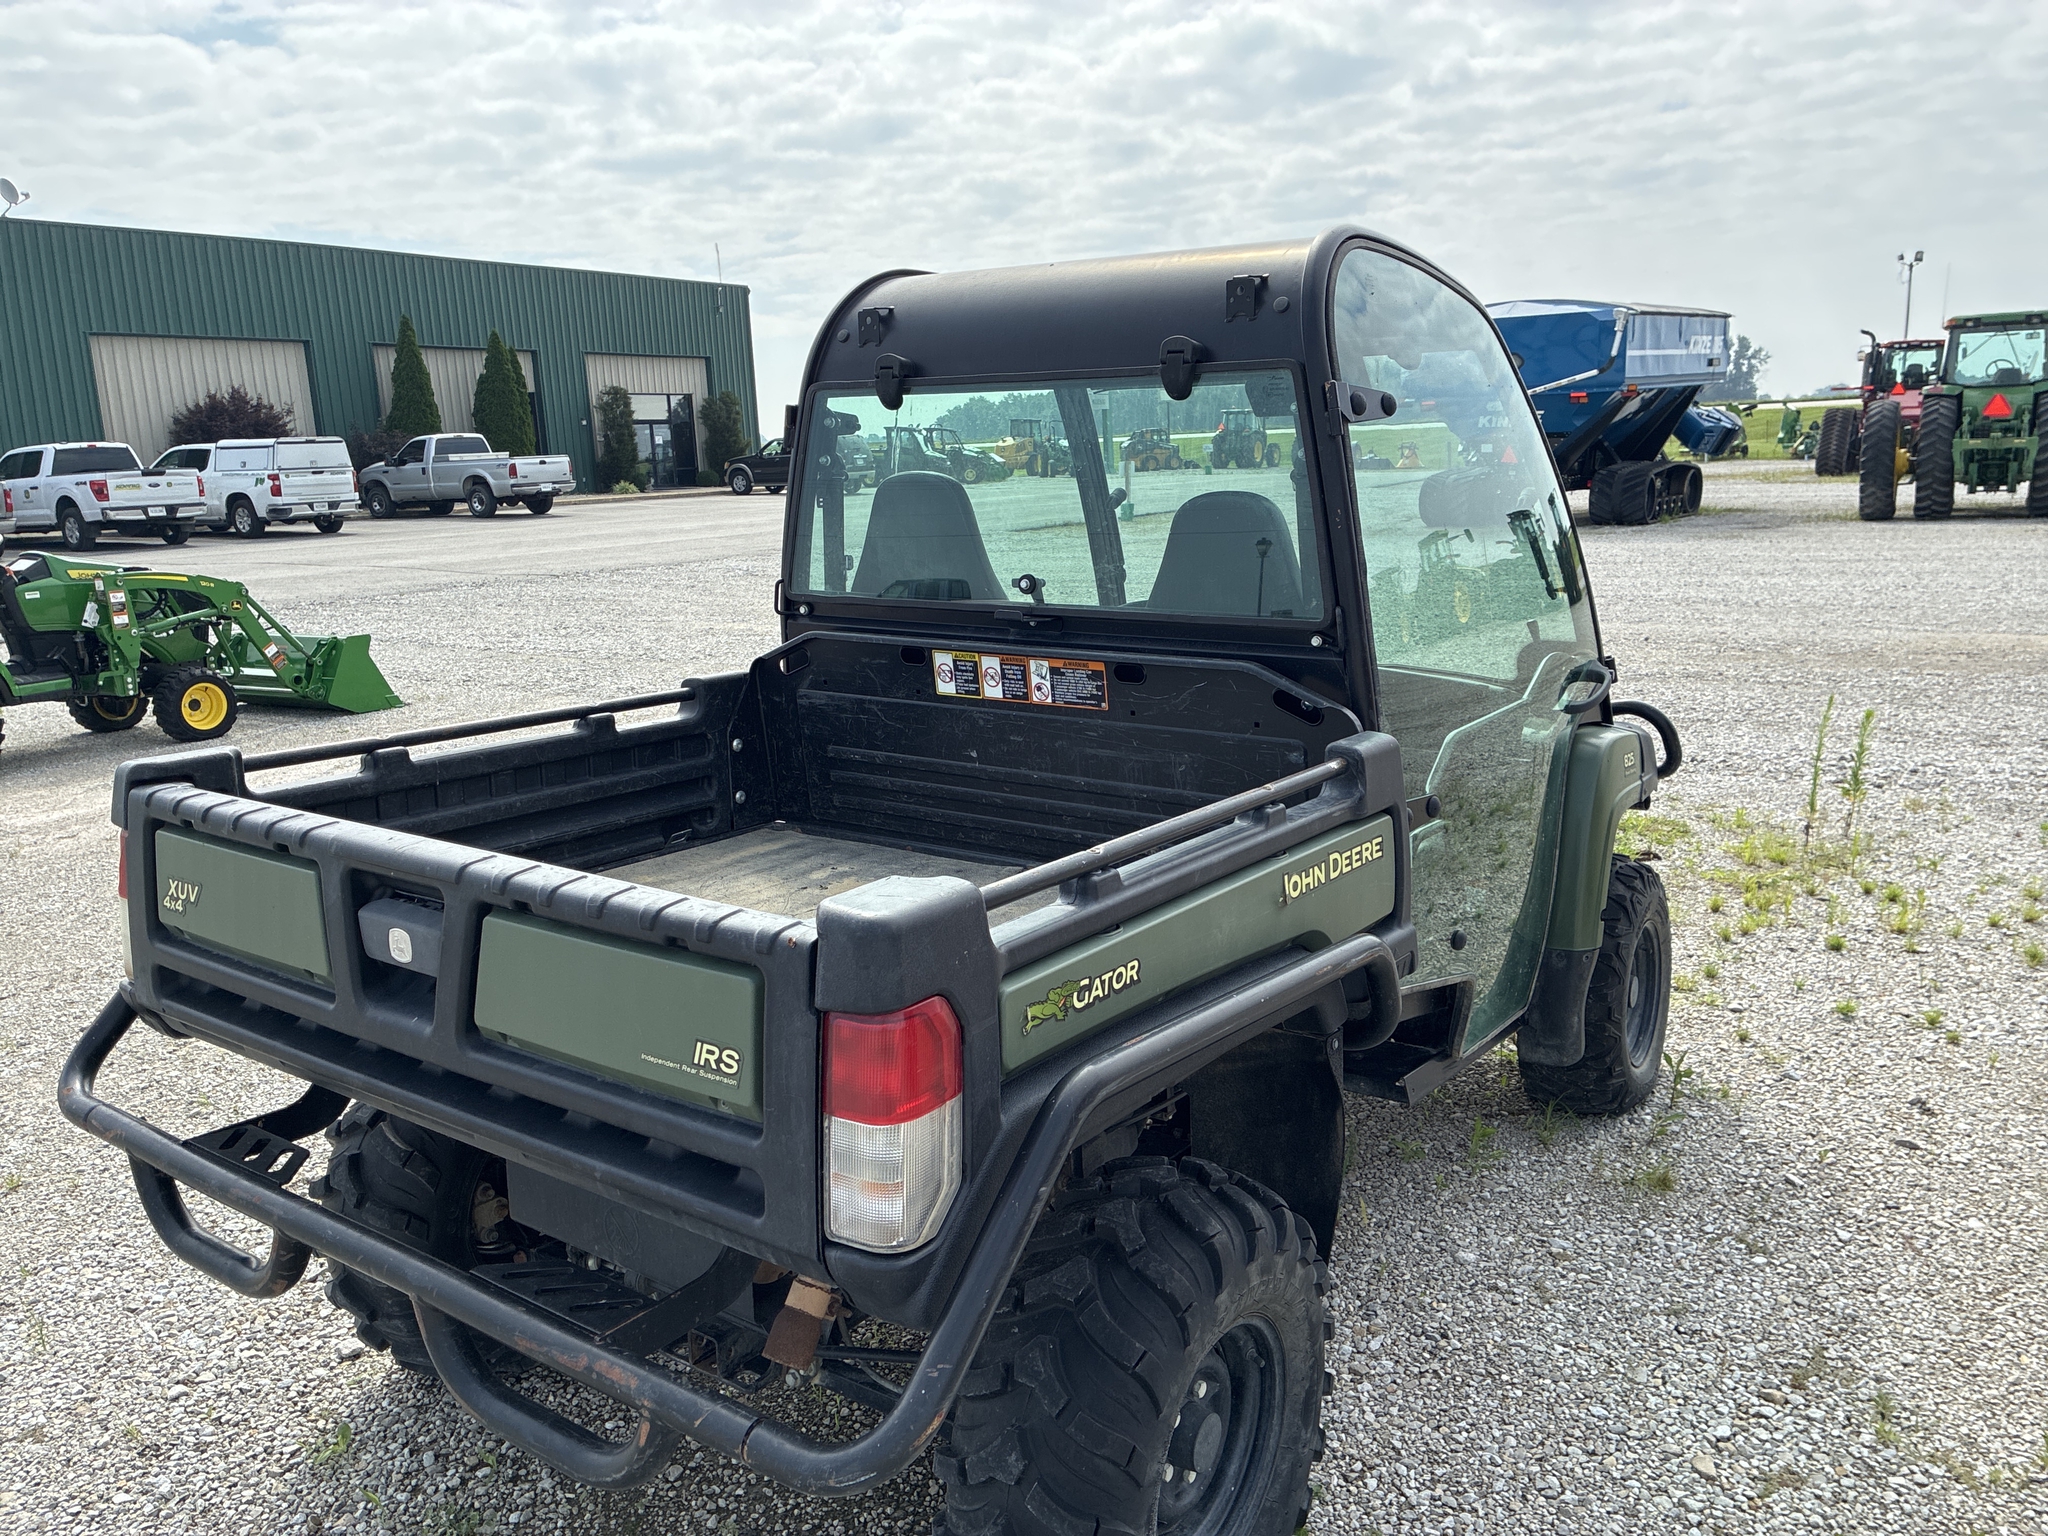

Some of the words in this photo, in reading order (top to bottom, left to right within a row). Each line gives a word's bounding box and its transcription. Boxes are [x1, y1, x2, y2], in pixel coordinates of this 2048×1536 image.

[1624, 753, 1635, 767] 825
[1283, 861, 1326, 901] JOHN
[1329, 836, 1383, 881] DEERE
[163, 895, 184, 912] 4x4
[167, 878, 199, 903] XUV
[1072, 959, 1139, 1009] GATOR
[641, 1052, 681, 1070] Independent
[681, 1064, 698, 1075] Rear
[698, 1069, 738, 1087] Suspension
[693, 1041, 740, 1075] IRS
